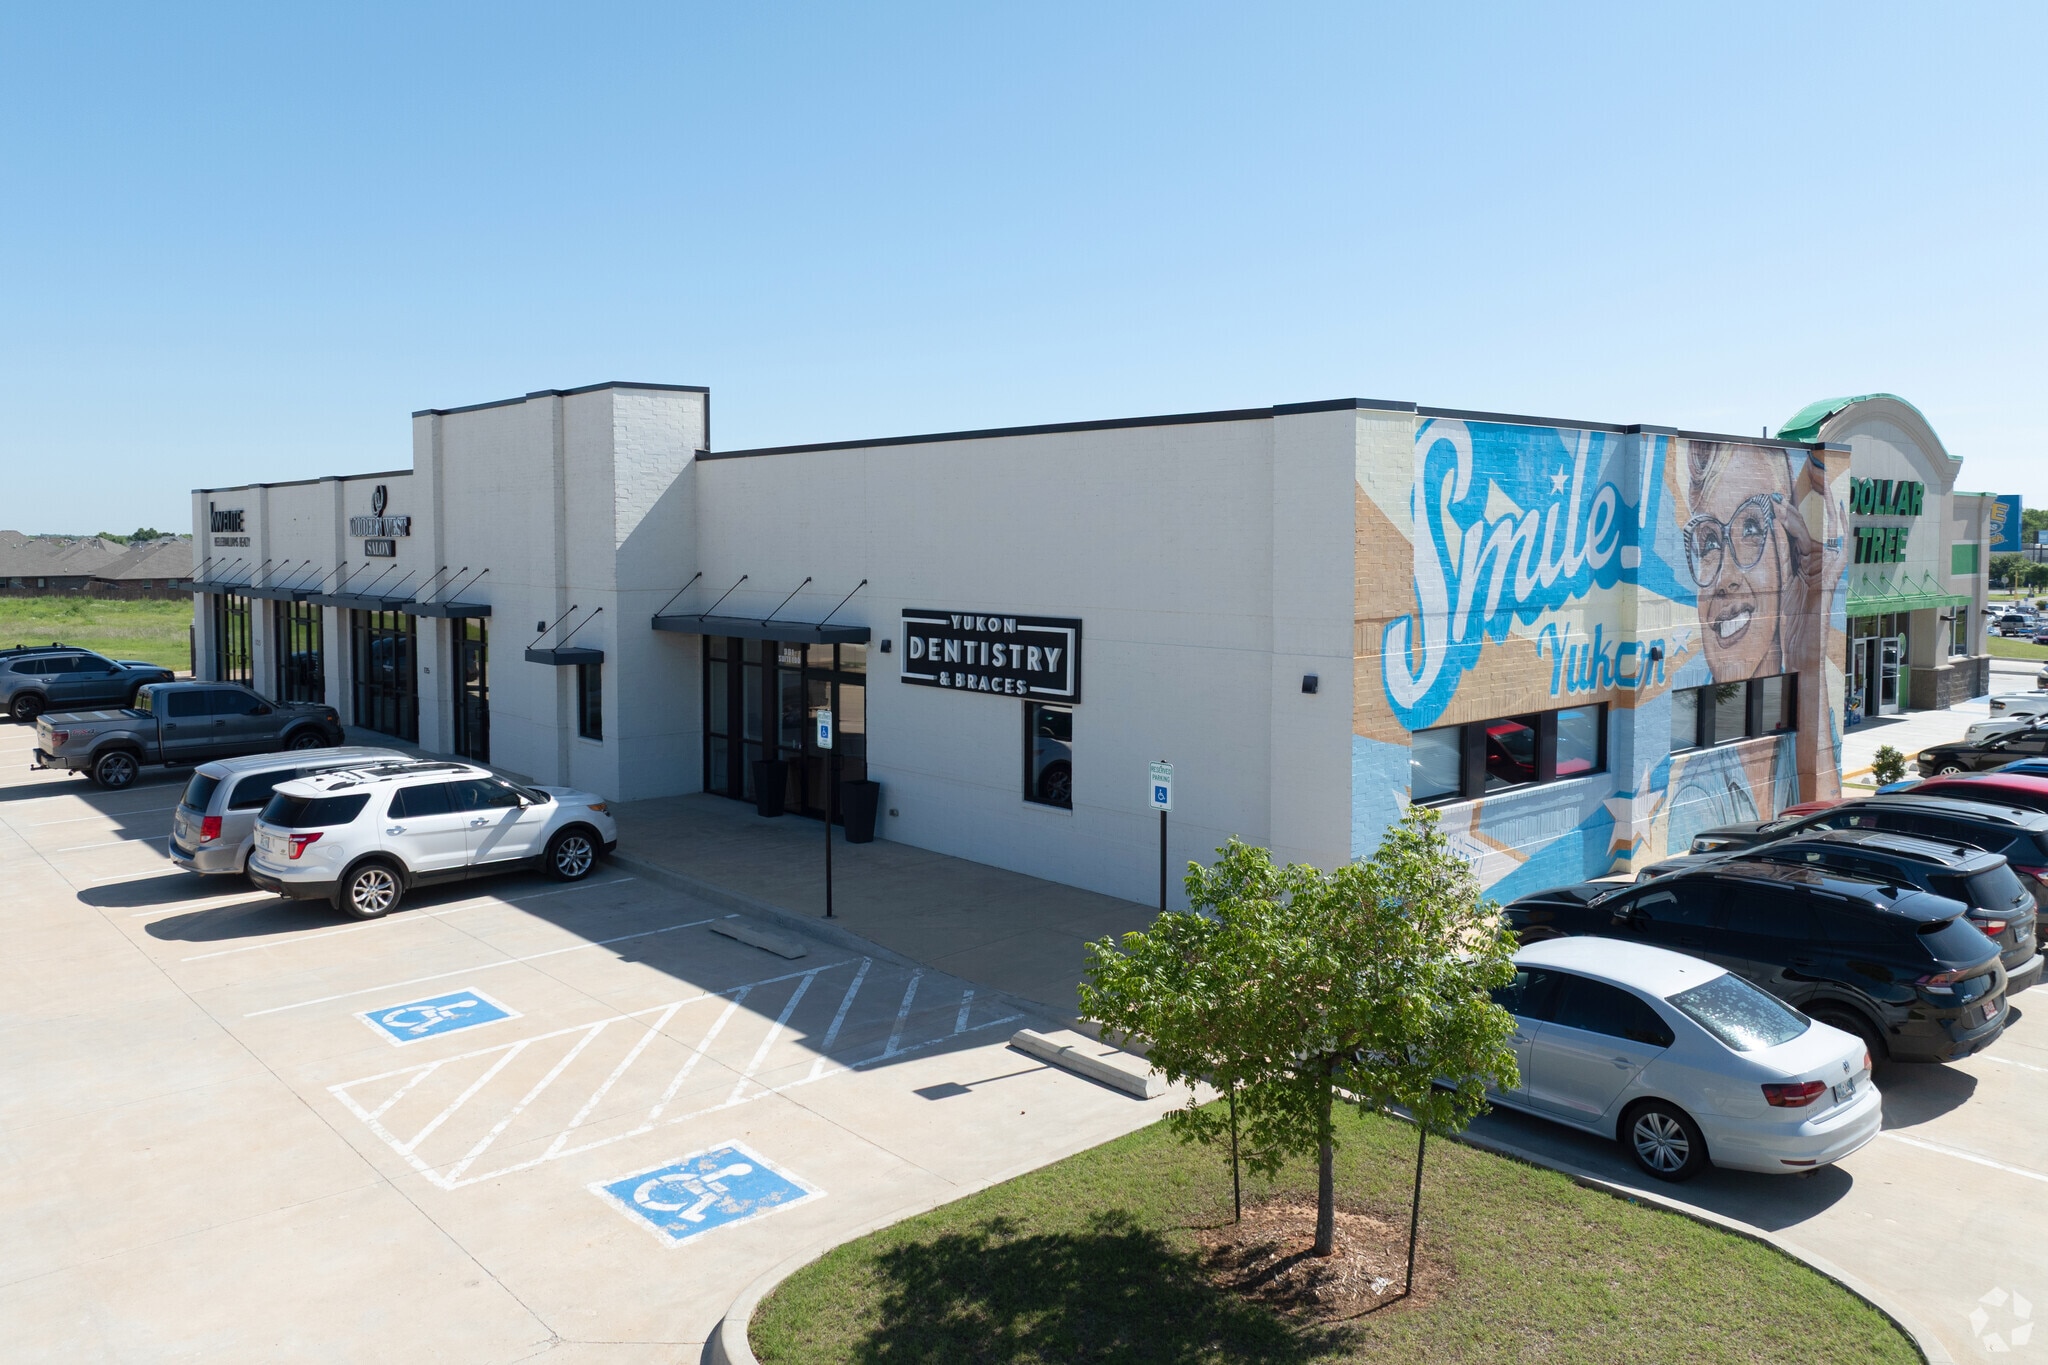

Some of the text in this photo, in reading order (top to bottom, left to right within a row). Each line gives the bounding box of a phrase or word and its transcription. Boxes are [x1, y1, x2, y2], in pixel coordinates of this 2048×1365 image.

[1850, 477, 1925, 516] DOLLAR
[350, 516, 411, 538] MODERN WEST
[367, 541, 391, 555] SALON
[1854, 527, 1908, 564] TREE
[1386, 418, 1655, 711] Smile!
[950, 614, 1017, 634] YUKON
[909, 635, 1063, 673] DENTISTRY
[1537, 619, 1667, 699] Yukon
[939, 671, 1028, 695] & BRACES
[1151, 765, 1171, 774] RESERVED
[1152, 773, 1170, 783] PARKING
